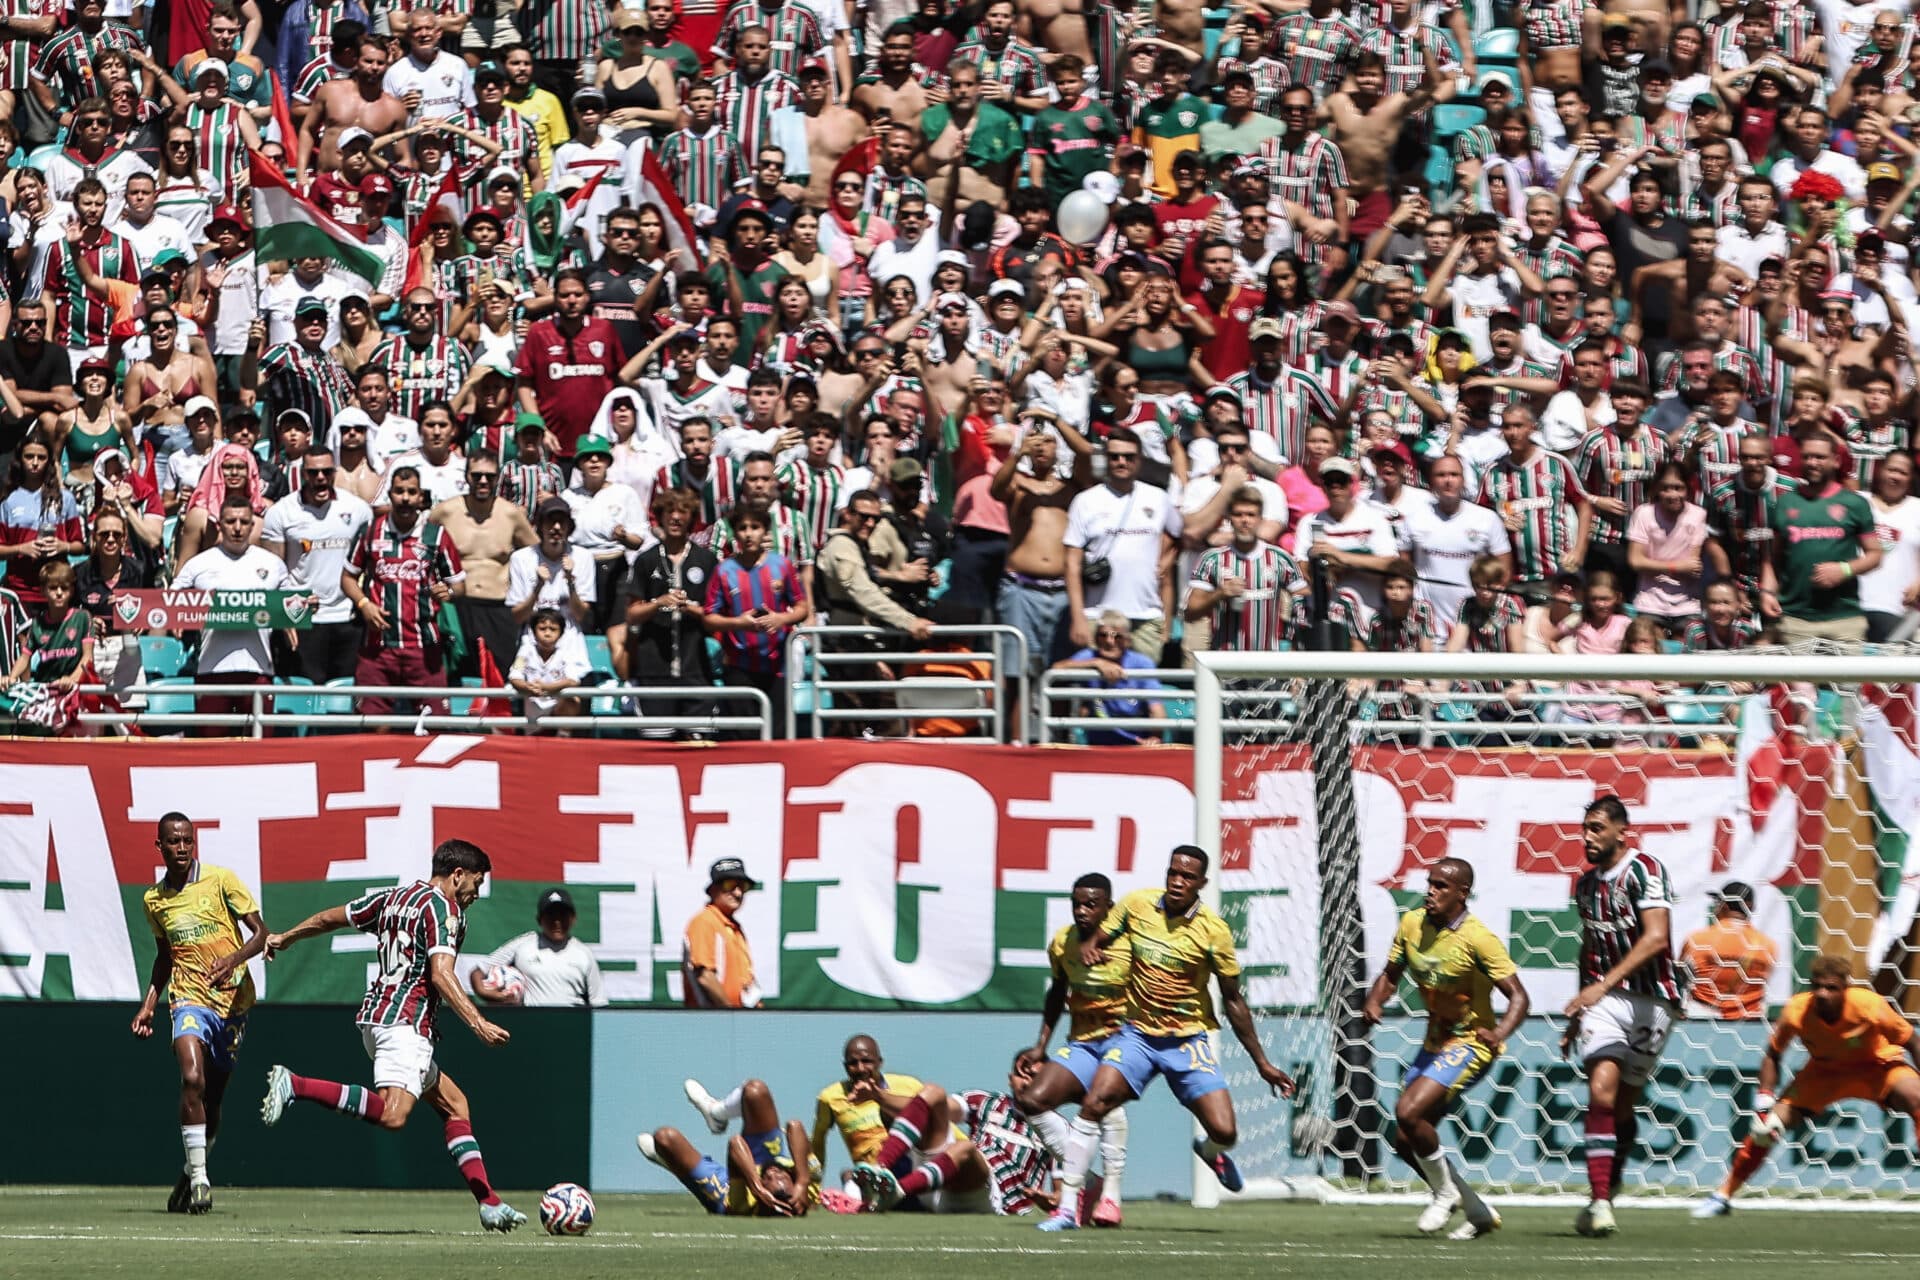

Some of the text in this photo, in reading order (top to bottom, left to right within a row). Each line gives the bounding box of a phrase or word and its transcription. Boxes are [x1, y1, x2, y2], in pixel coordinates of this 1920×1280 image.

[217, 591, 266, 606] TOUR
[177, 612, 249, 622] FLUMINENSE
[380, 929, 411, 985] 16
[1180, 1041, 1214, 1067] 20
